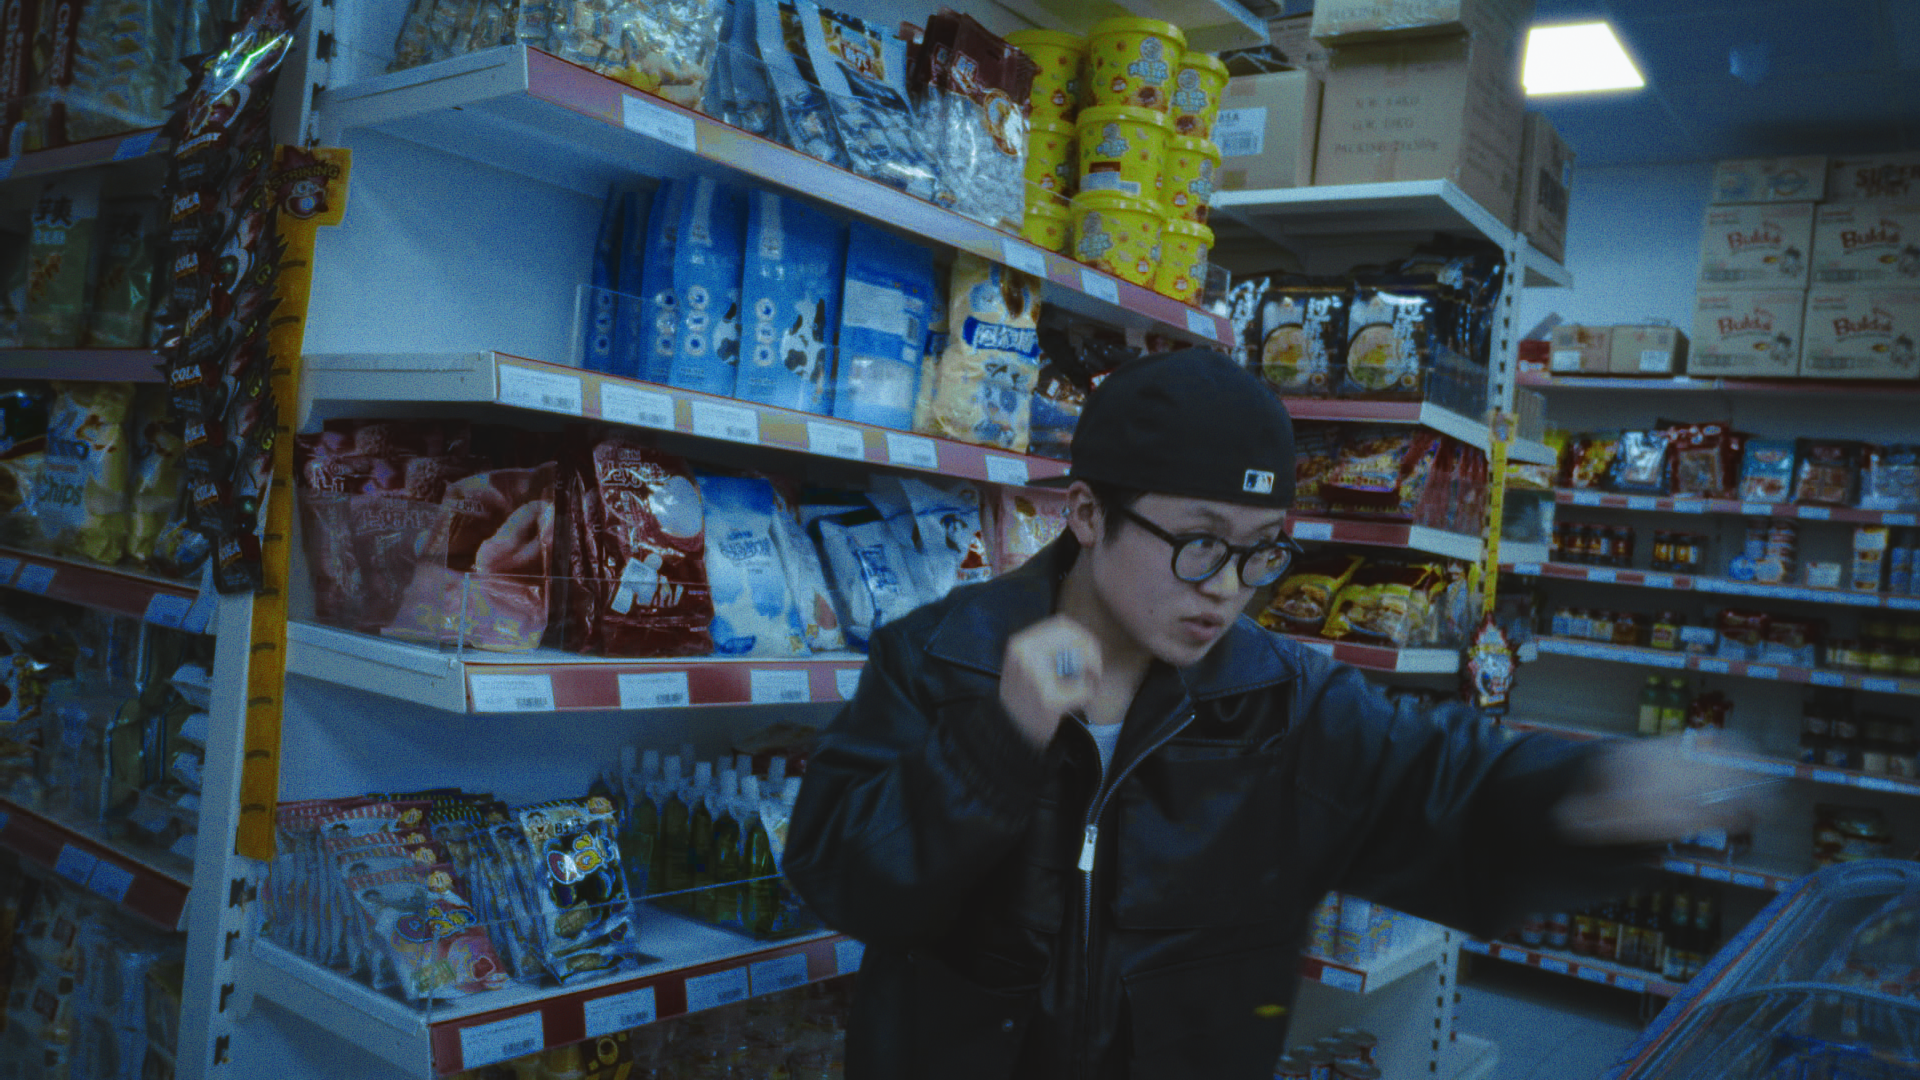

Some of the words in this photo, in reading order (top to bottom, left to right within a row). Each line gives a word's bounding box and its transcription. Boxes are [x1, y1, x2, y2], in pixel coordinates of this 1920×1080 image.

[271, 164, 340, 189] STRIKING
[175, 252, 199, 272] COLA
[171, 364, 202, 385] COLA
